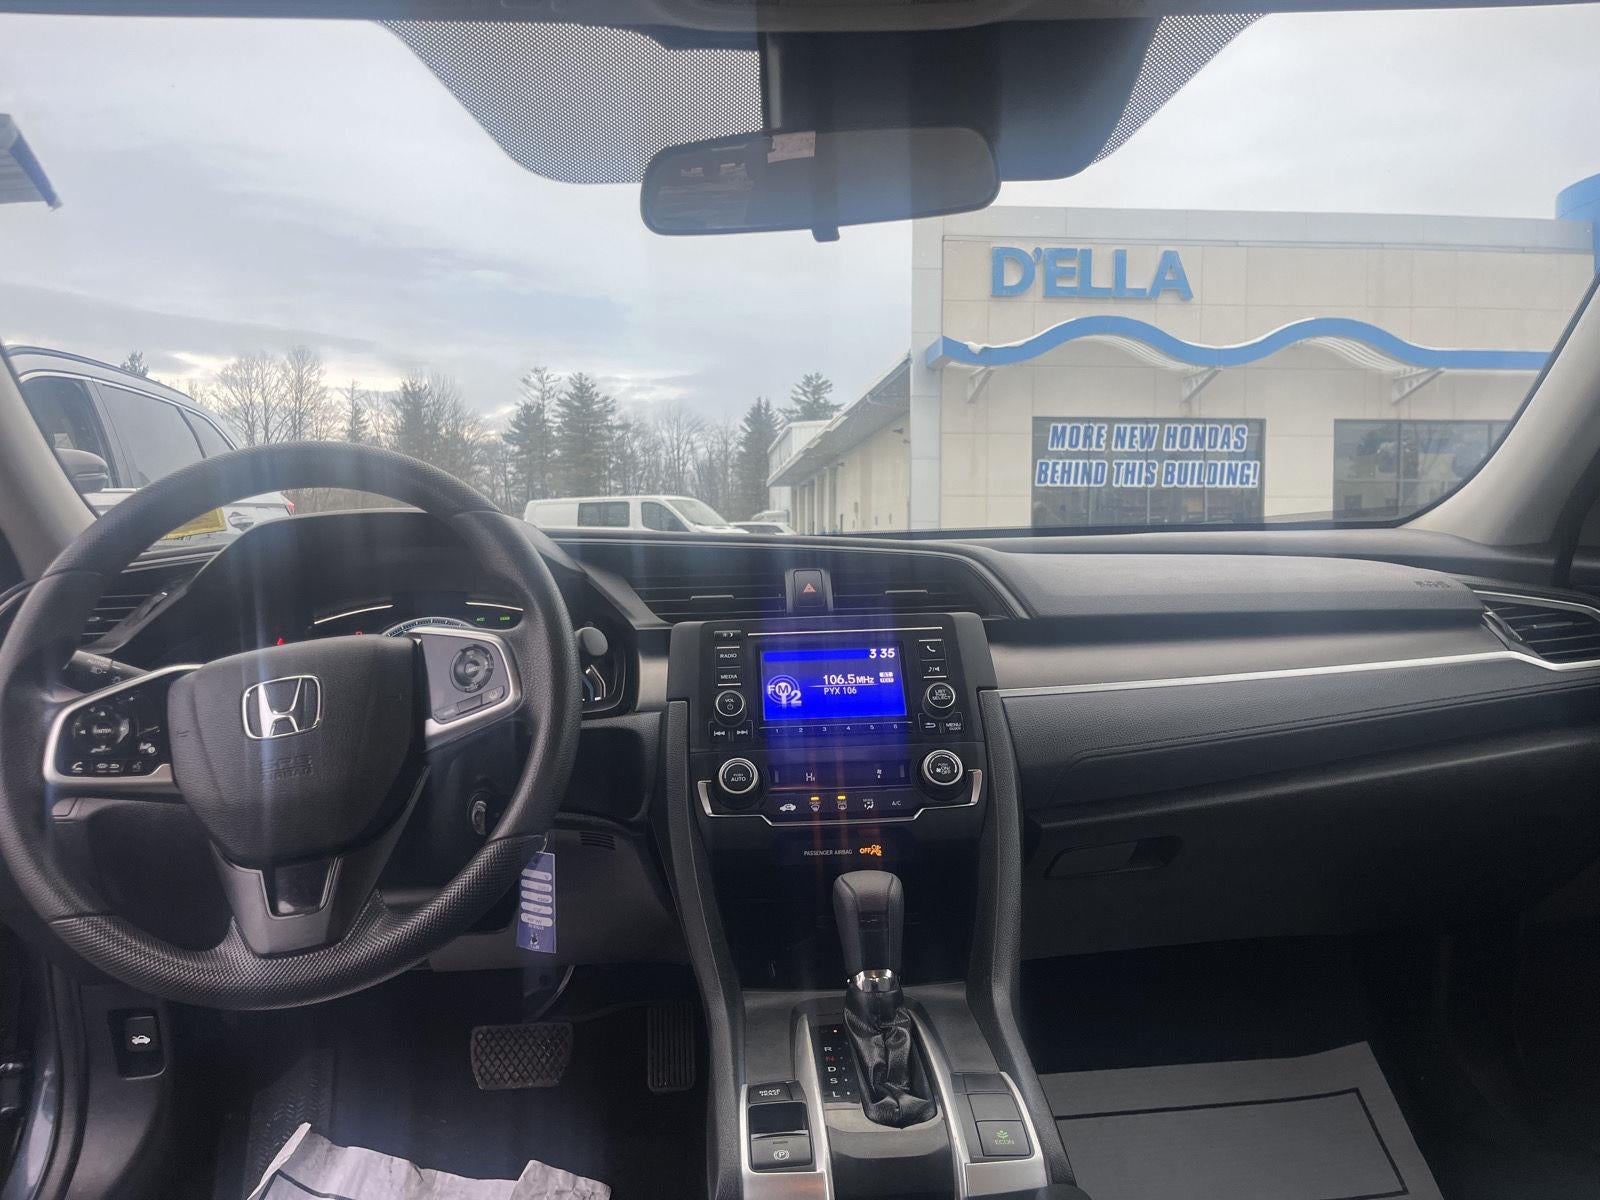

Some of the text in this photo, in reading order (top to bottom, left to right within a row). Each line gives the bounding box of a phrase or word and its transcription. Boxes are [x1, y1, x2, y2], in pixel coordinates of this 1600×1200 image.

[990, 246, 1194, 300] D'ELLA
[1048, 423, 1249, 451] MORE NEW HONDAS
[1034, 460, 1261, 488] BEHIND THIS BUILDING!
